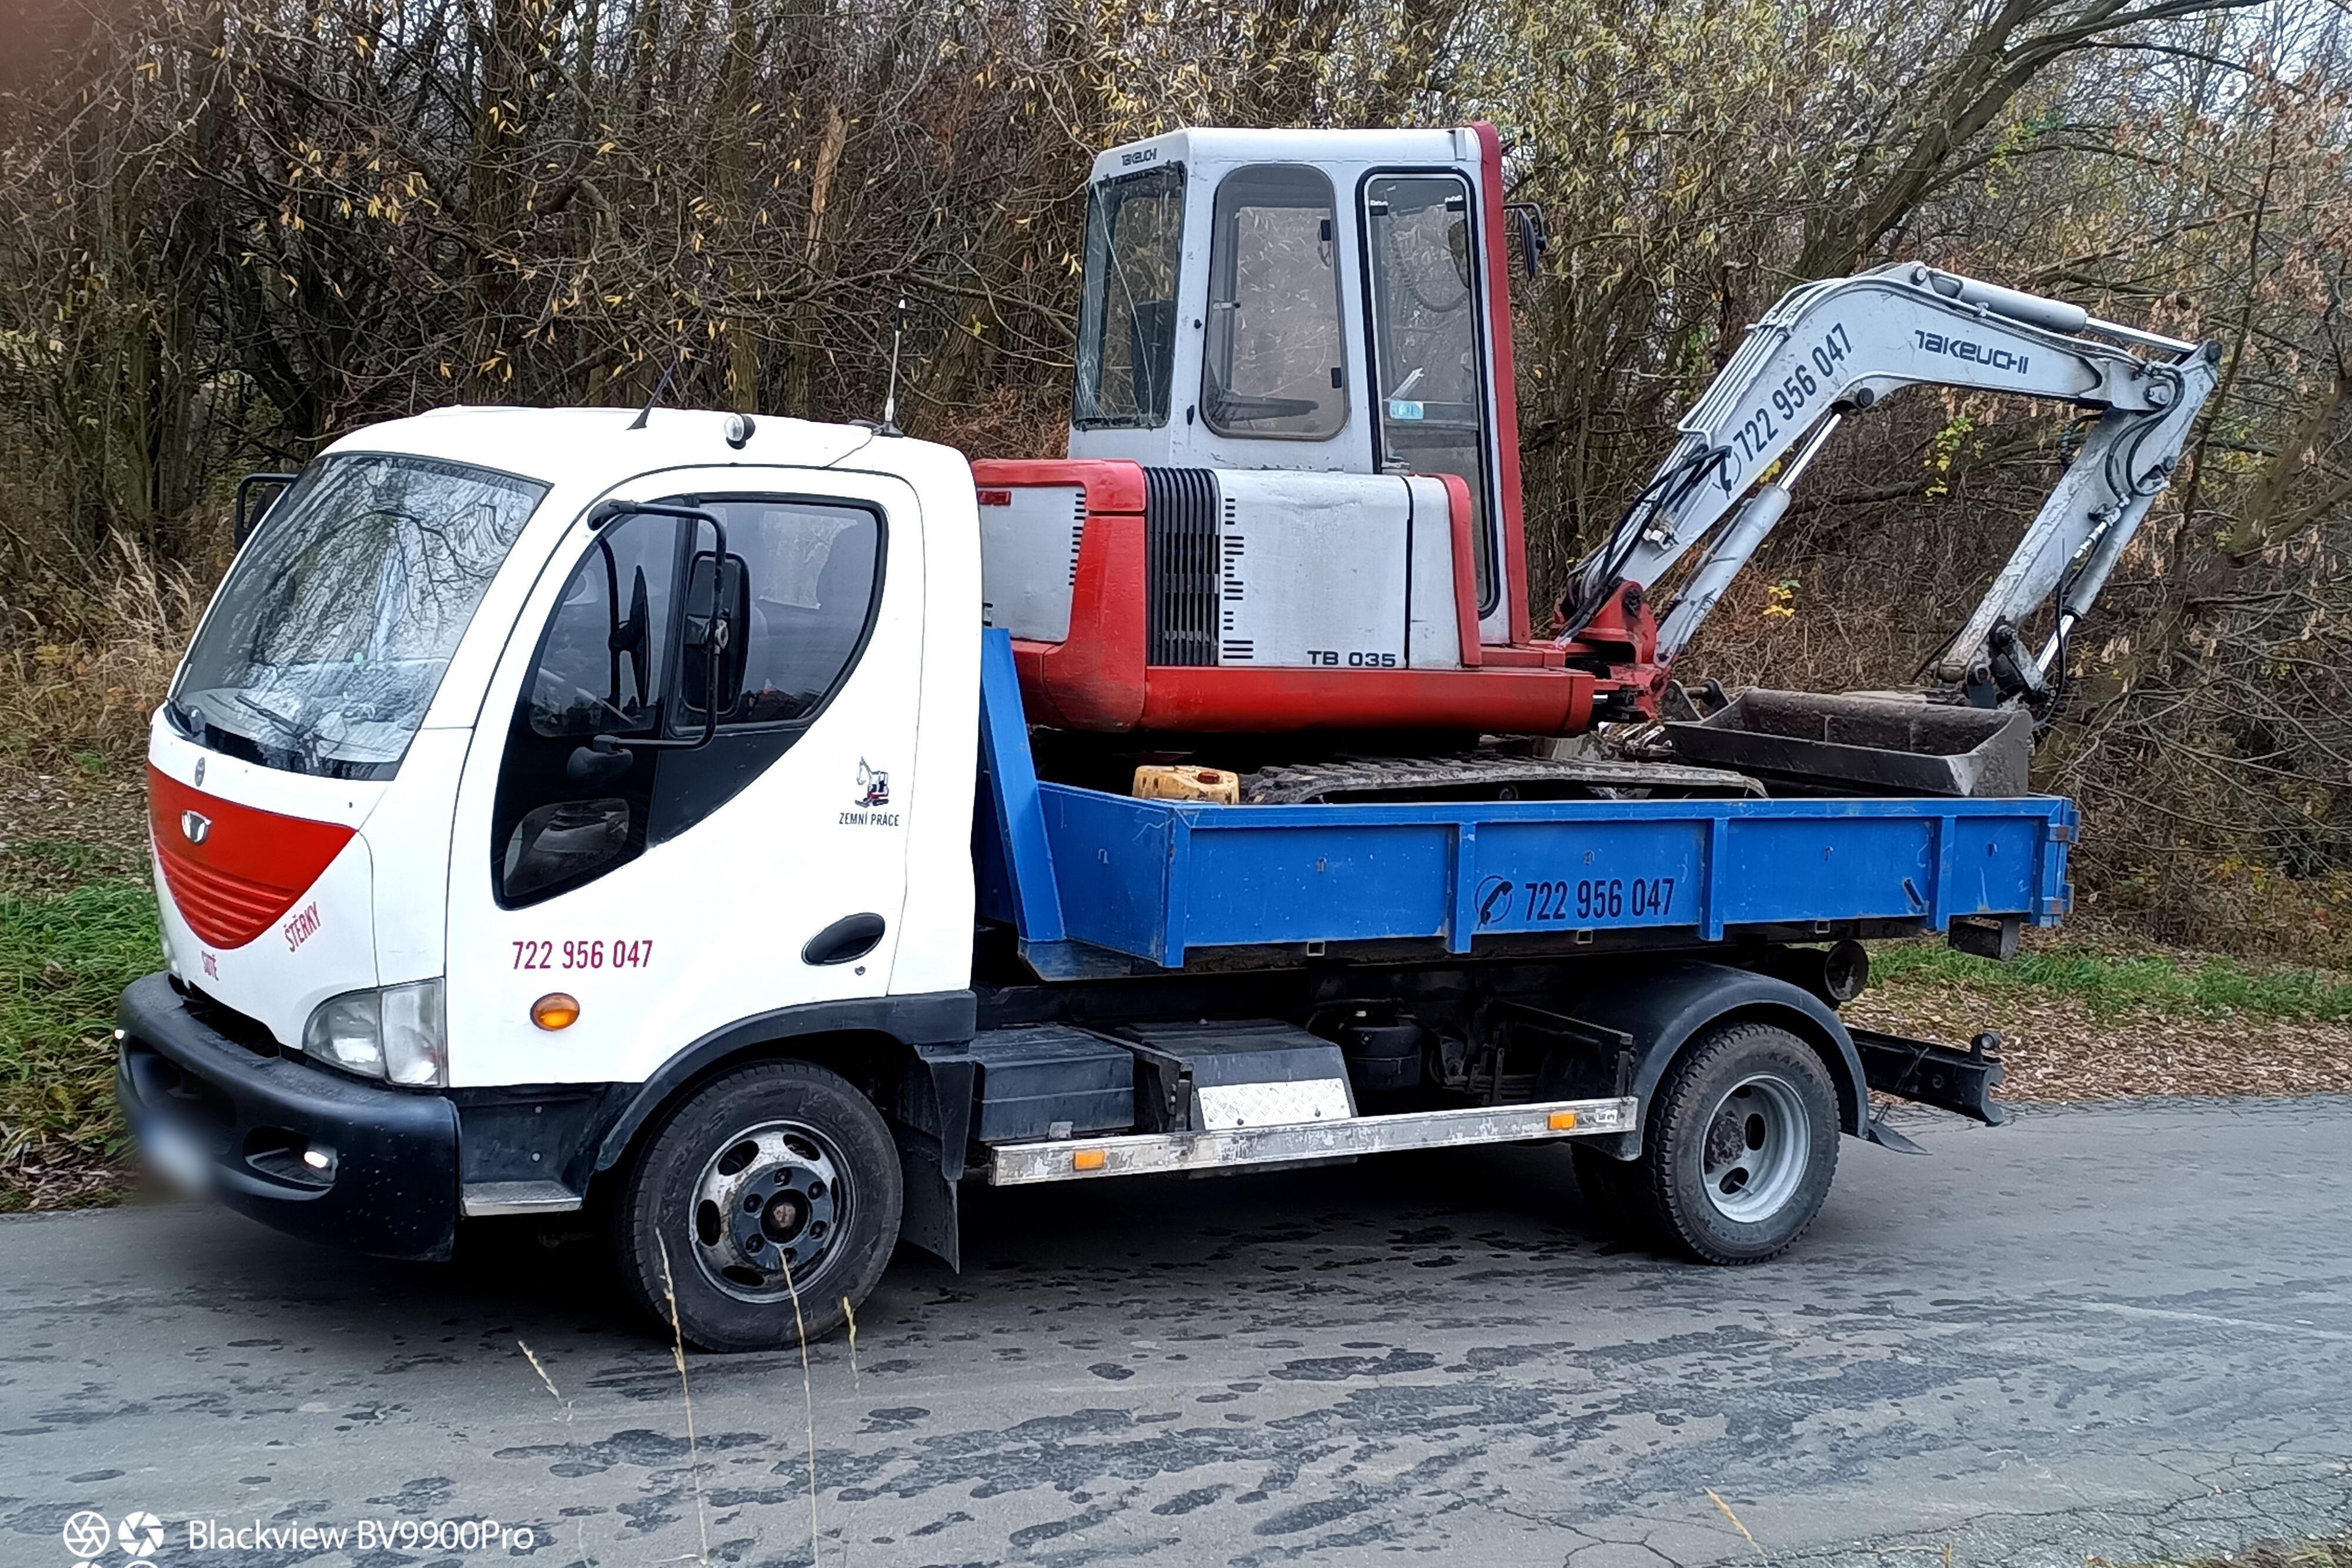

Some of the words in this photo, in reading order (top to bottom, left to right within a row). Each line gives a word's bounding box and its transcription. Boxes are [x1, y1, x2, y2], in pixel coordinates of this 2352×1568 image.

[1732, 408, 1779, 462] 722
[1772, 364, 1817, 420] 956
[1812, 322, 1852, 377] 047
[1307, 650, 1339, 666] TB
[1348, 652, 1396, 667] 035
[838, 811, 868, 825] ZEMNÍ
[870, 811, 900, 827] PRÁCE
[1525, 881, 1568, 921] 722
[1576, 879, 1623, 919] 956
[1632, 878, 1675, 917] 047
[283, 901, 321, 952] ŠTĚRKY
[512, 941, 553, 970] 722
[562, 940, 604, 969] 956
[613, 940, 653, 968] 047
